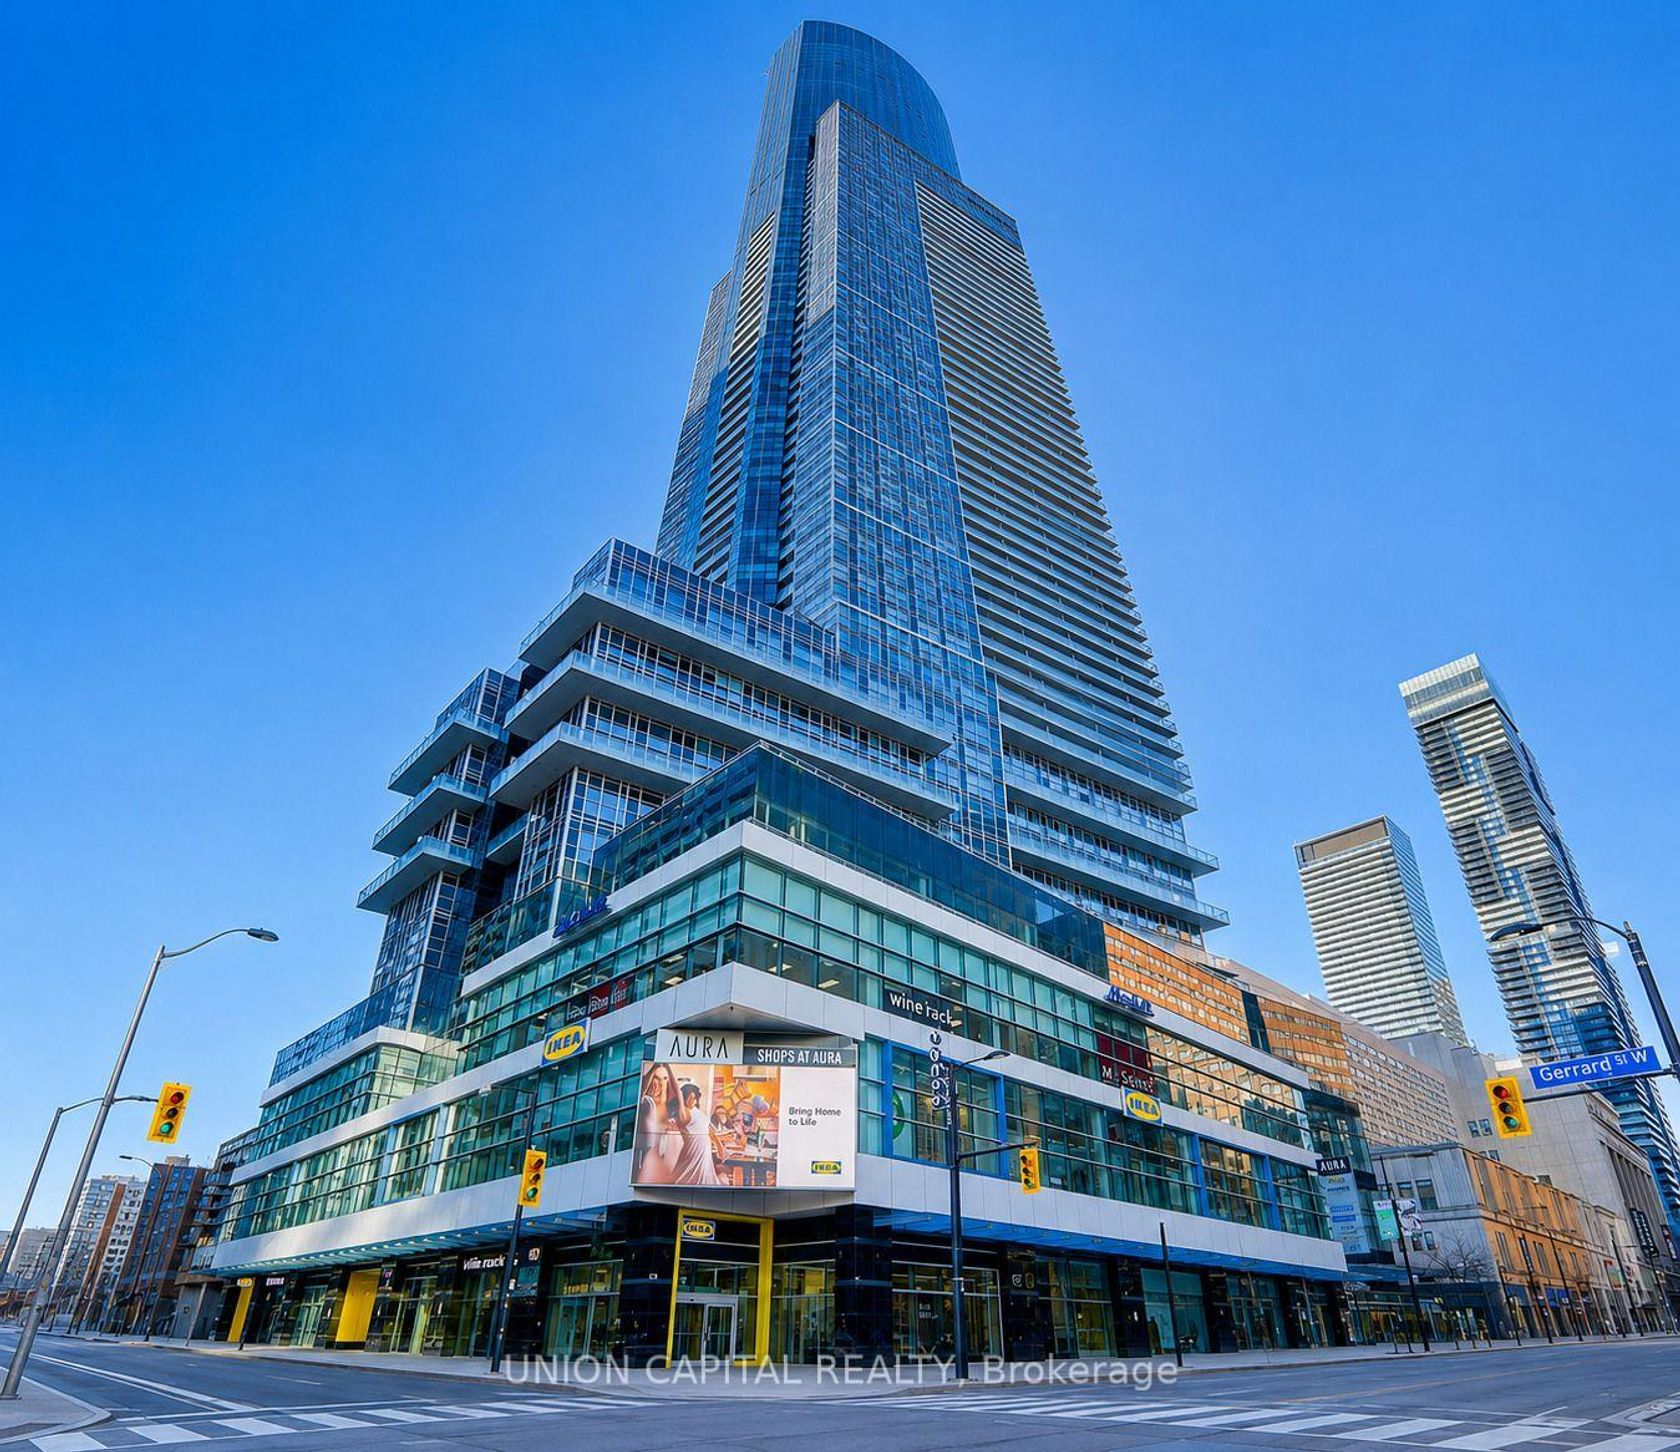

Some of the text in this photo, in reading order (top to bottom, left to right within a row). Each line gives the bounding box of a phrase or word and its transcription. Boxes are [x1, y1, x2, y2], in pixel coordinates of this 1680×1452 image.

[889, 992, 953, 1025] wine rack
[546, 1030, 581, 1055] IKEA
[669, 1035, 728, 1059] AURA
[757, 1048, 842, 1065] SHOPS AT AURA
[1539, 1056, 1611, 1081] Gerrard
[1631, 1049, 1648, 1065] W
[788, 1106, 841, 1118] Bring Home
[788, 1117, 817, 1126] to Life
